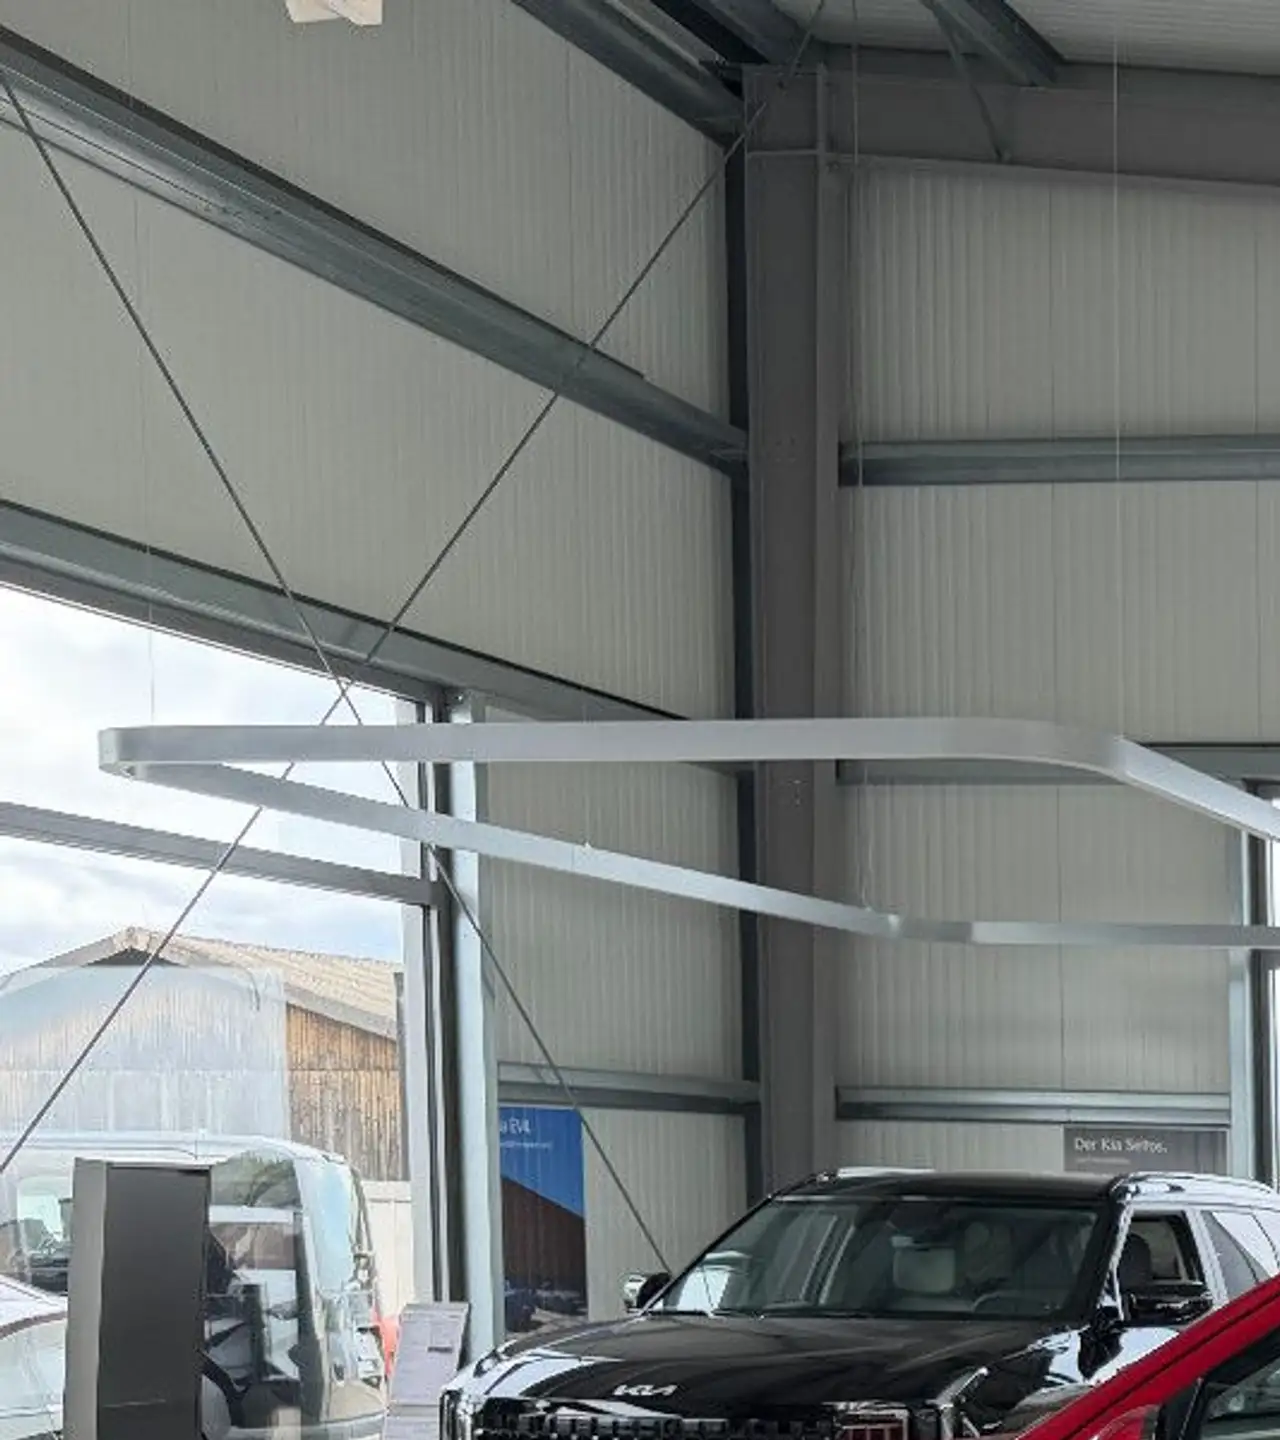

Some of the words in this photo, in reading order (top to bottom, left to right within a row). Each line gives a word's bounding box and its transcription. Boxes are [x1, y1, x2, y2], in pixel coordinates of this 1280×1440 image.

[1074, 1137, 1097, 1151] Der
[1101, 1137, 1123, 1152] Kia
[613, 1384, 678, 1396] KIA
